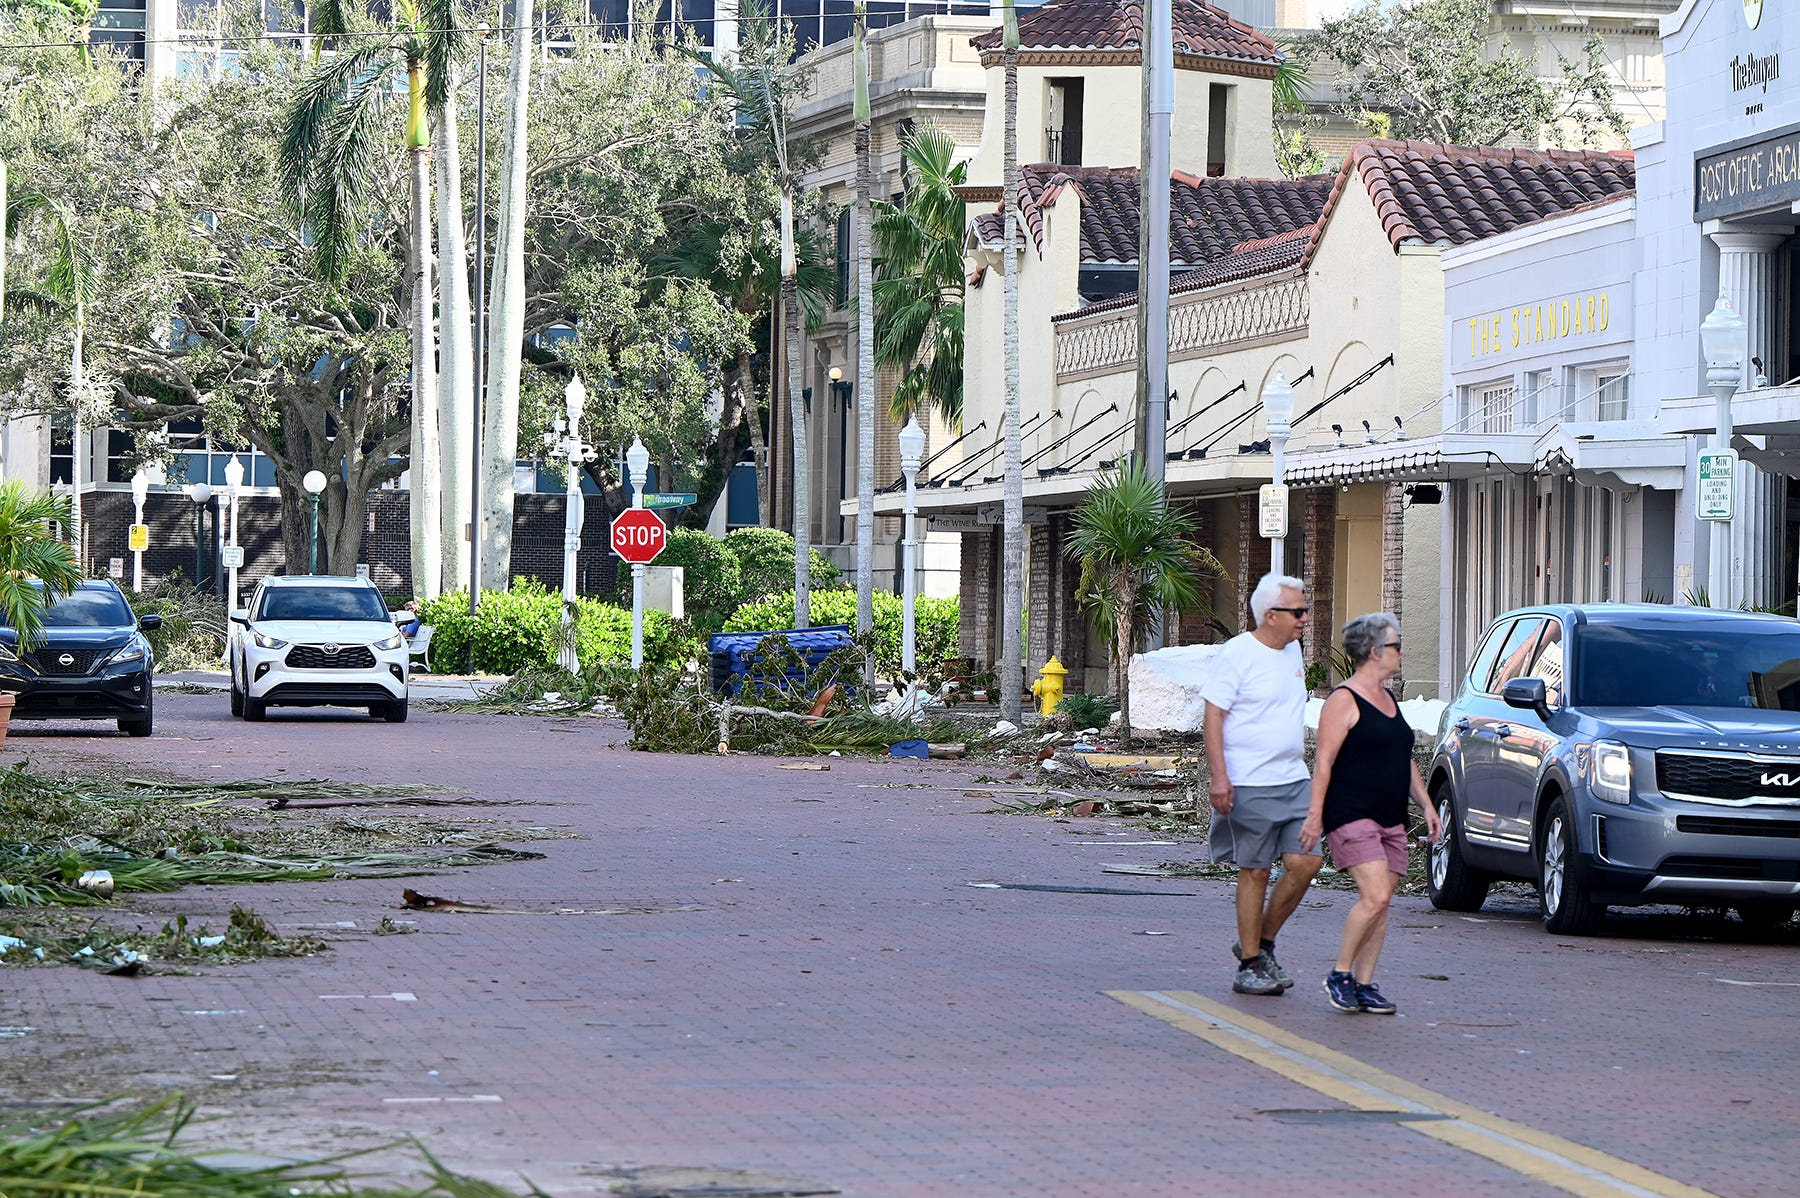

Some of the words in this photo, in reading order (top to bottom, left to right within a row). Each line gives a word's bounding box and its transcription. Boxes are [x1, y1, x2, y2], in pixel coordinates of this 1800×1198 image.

[1747, 52, 1780, 94] Banyan
[1700, 160, 1727, 204] POST
[1728, 150, 1764, 198] OFFICE
[1470, 315, 1502, 357] THE
[1511, 292, 1610, 348] STANDARD
[1700, 462, 1710, 474] 30
[1715, 458, 1727, 466] MIN
[1711, 468, 1730, 476] PARKING
[936, 518, 951, 527] THE
[951, 518, 971, 528] WINE
[615, 525, 662, 546] STOP
